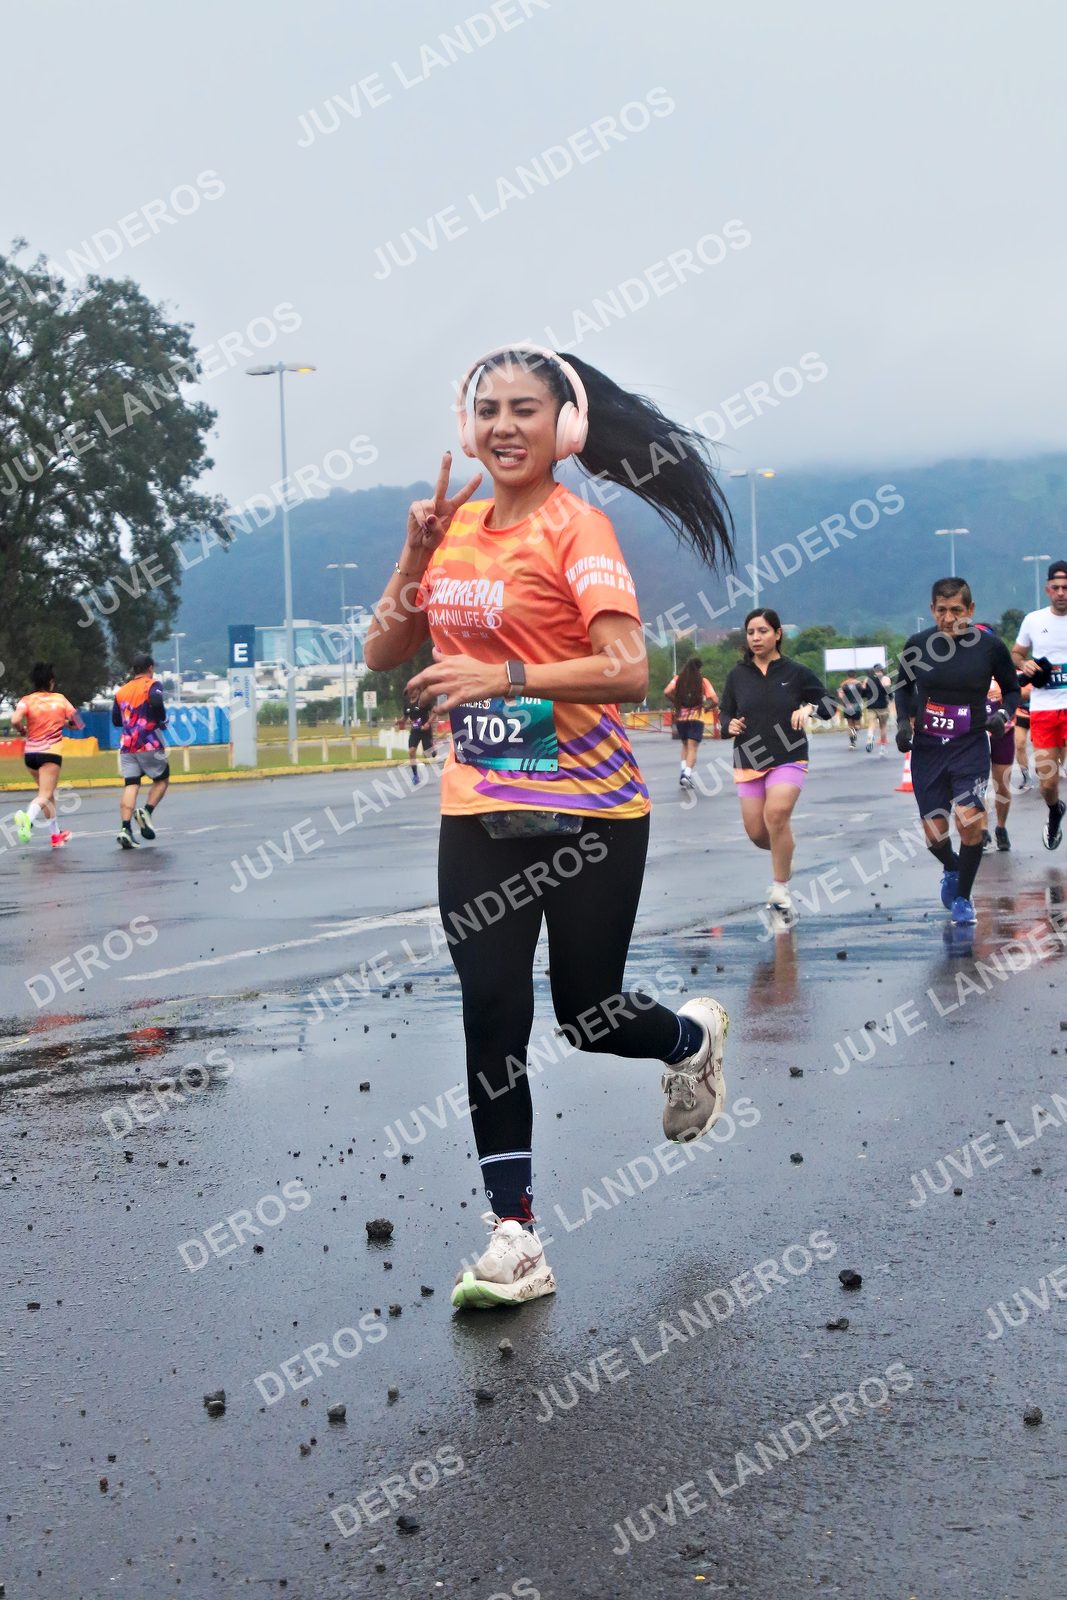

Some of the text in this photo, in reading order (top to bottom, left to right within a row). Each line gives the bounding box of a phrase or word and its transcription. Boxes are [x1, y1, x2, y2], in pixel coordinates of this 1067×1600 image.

[428, 610, 481, 628] OMNILIFE
[234, 642, 248, 662] E
[463, 715, 523, 743] 1702
[932, 716, 954, 730] 273
